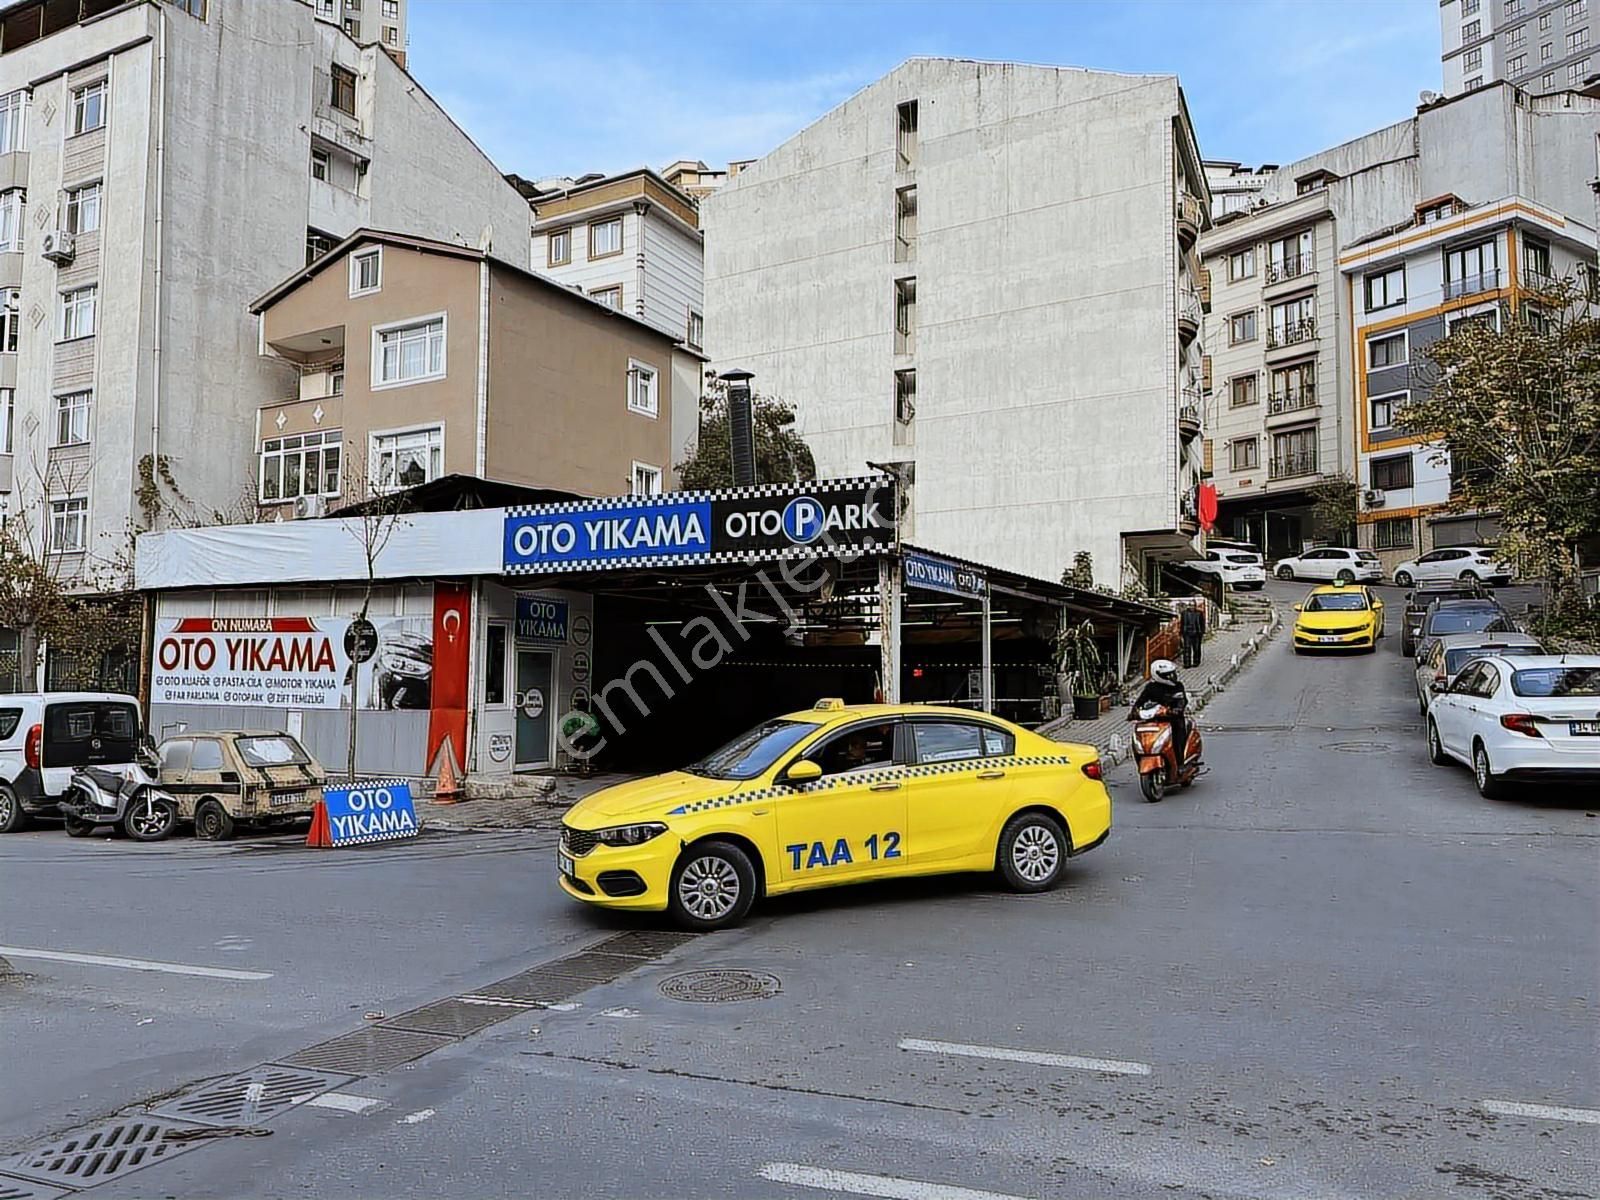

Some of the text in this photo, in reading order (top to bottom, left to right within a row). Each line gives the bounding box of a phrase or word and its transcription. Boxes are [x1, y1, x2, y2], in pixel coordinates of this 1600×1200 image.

[513, 513, 706, 556] OTO YIKAMA
[530, 601, 556, 619] OTO
[212, 619, 273, 632] ON NUMARA
[518, 619, 565, 639] YIKAMA
[158, 637, 216, 671] OTO
[226, 637, 336, 672] YIKAMA
[164, 676, 180, 686] OTO
[274, 678, 302, 688] MOTOR
[305, 679, 336, 689] YIKAMA
[347, 789, 393, 813] OTO
[332, 808, 414, 837] YIKAMA
[786, 831, 901, 871] TAA 12
